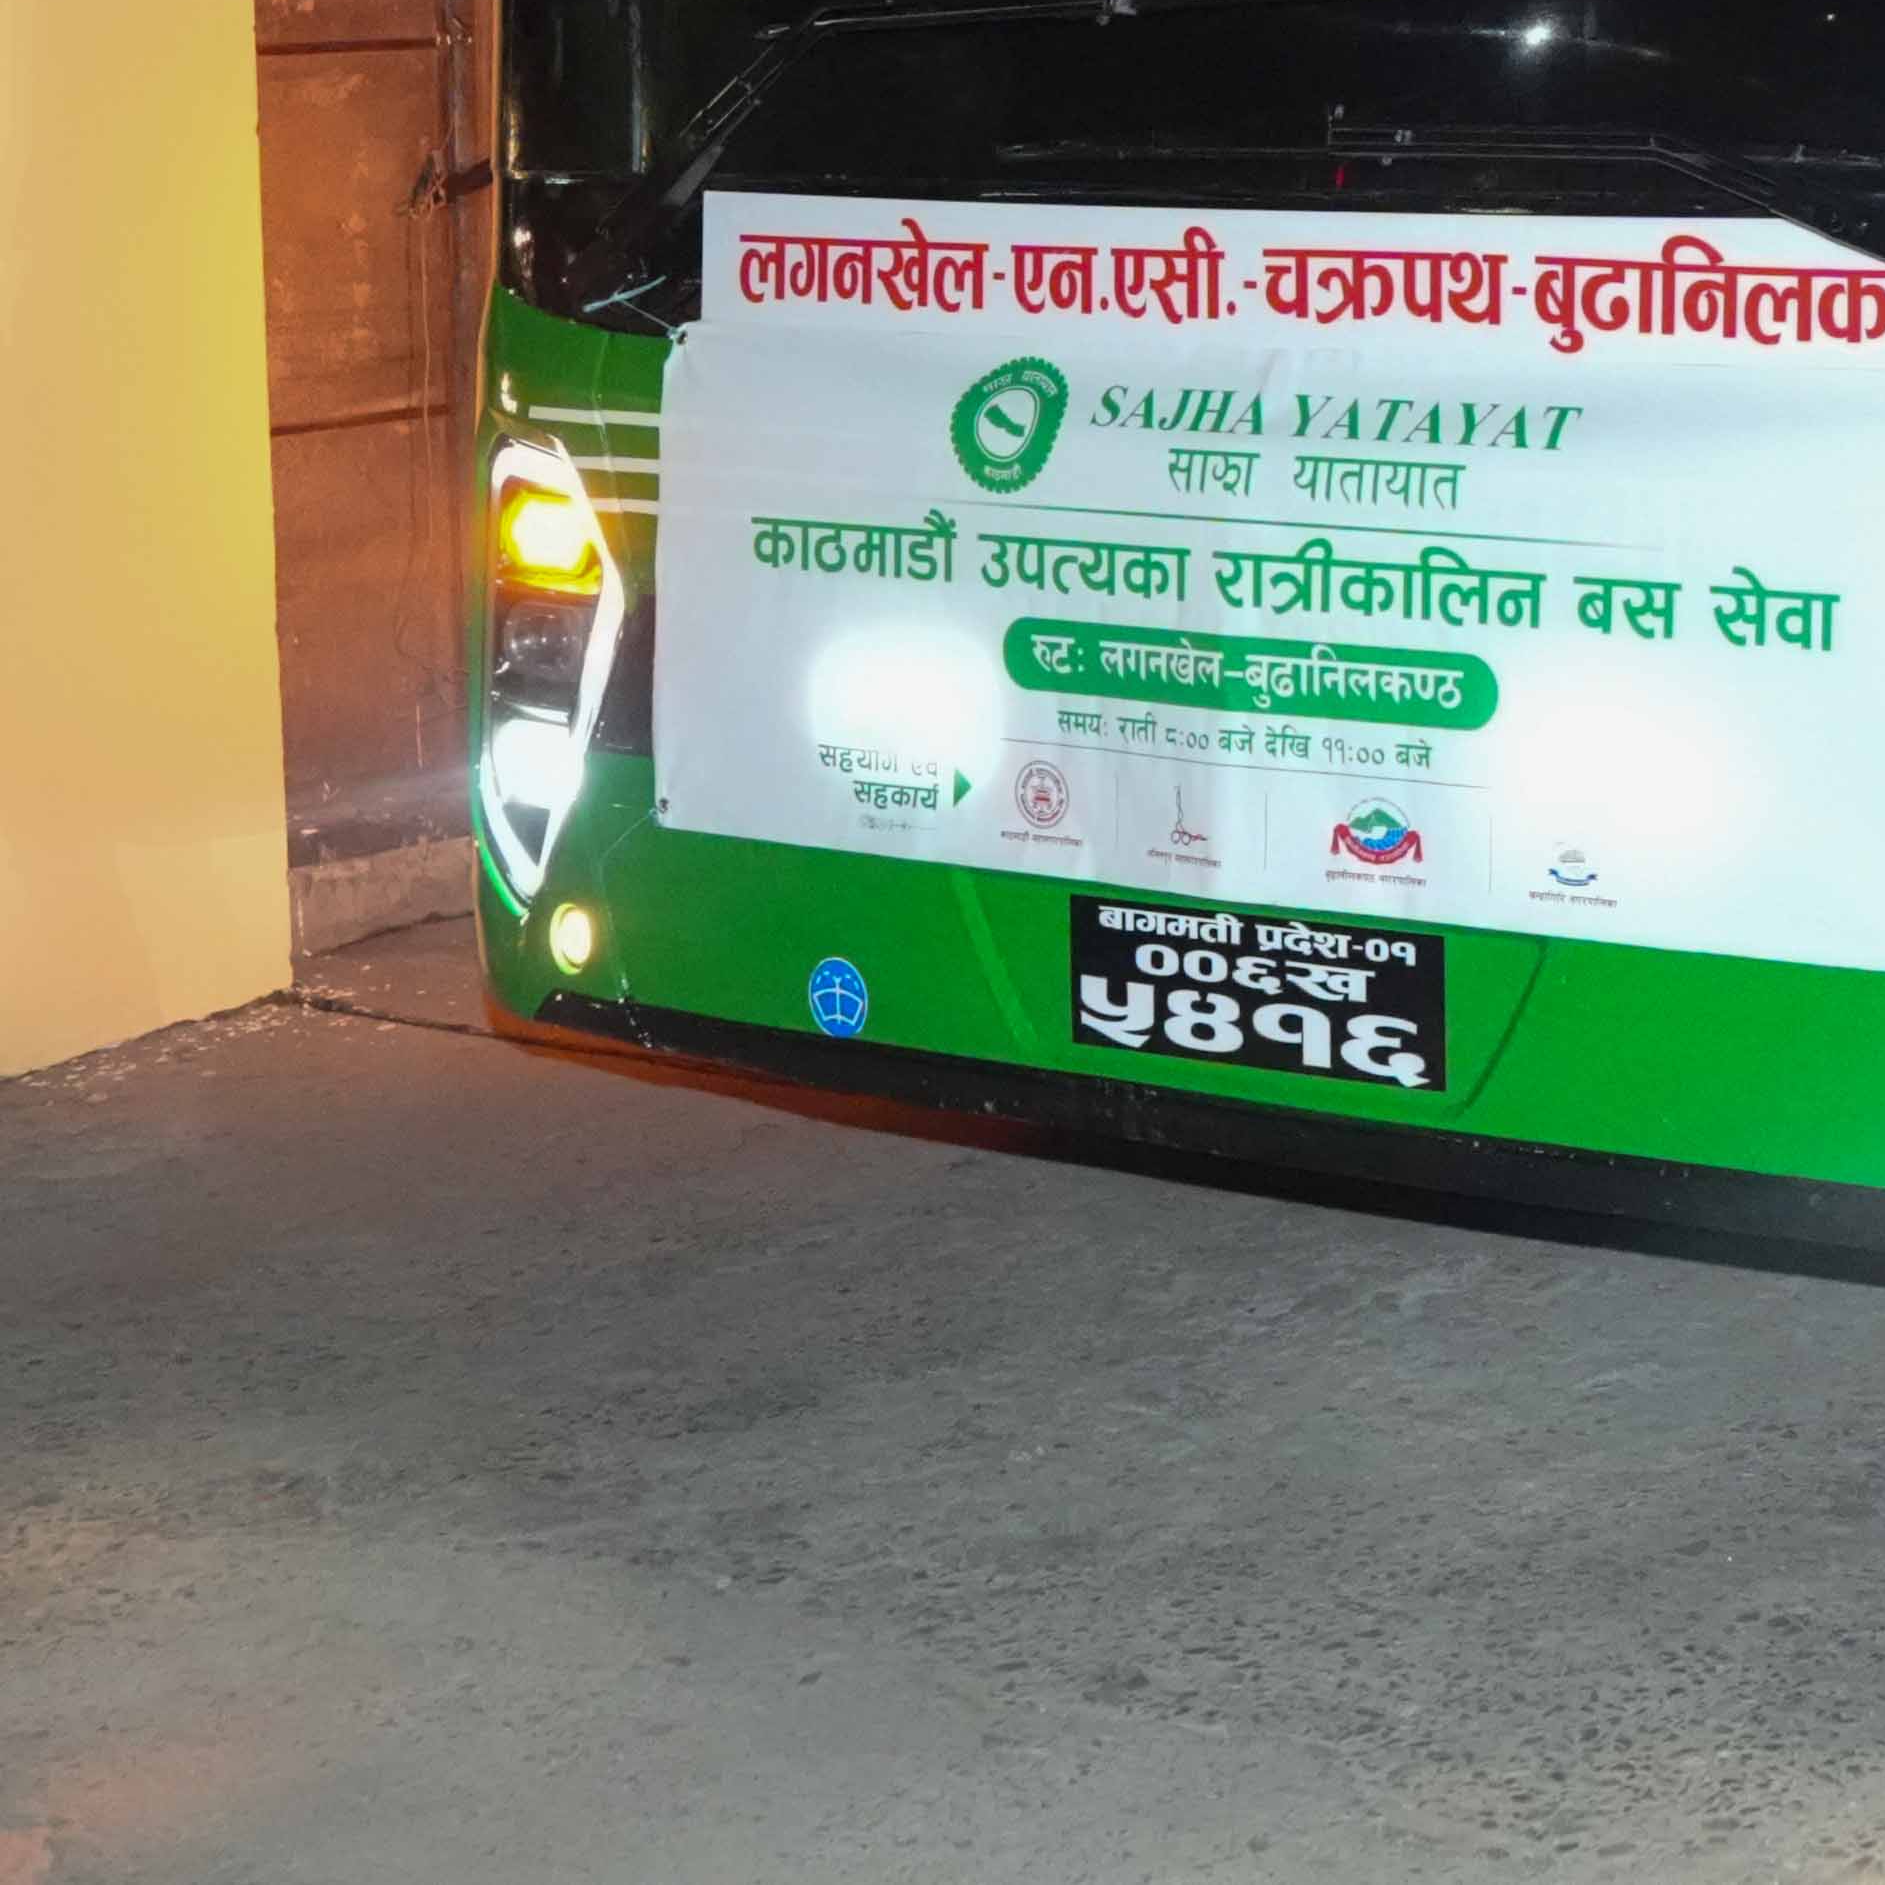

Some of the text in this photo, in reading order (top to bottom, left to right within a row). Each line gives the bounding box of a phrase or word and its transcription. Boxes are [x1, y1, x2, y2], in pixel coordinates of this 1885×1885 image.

[1091, 385, 1584, 451] SAJHA YATAYAT
[1168, 448, 1466, 510] साझा यातायात
[751, 509, 1841, 651] काठमाडौं उपत्यका रात्रीकालिन बस सेवा
[1219, 723, 1254, 754] बजे
[1265, 726, 1309, 760] देखि
[1395, 739, 1431, 769] बजे
[853, 779, 939, 810] सहकार्य
[1099, 905, 1416, 967] बागमती प्रदेश-०१
[1080, 974, 1430, 1088] ५४१६
